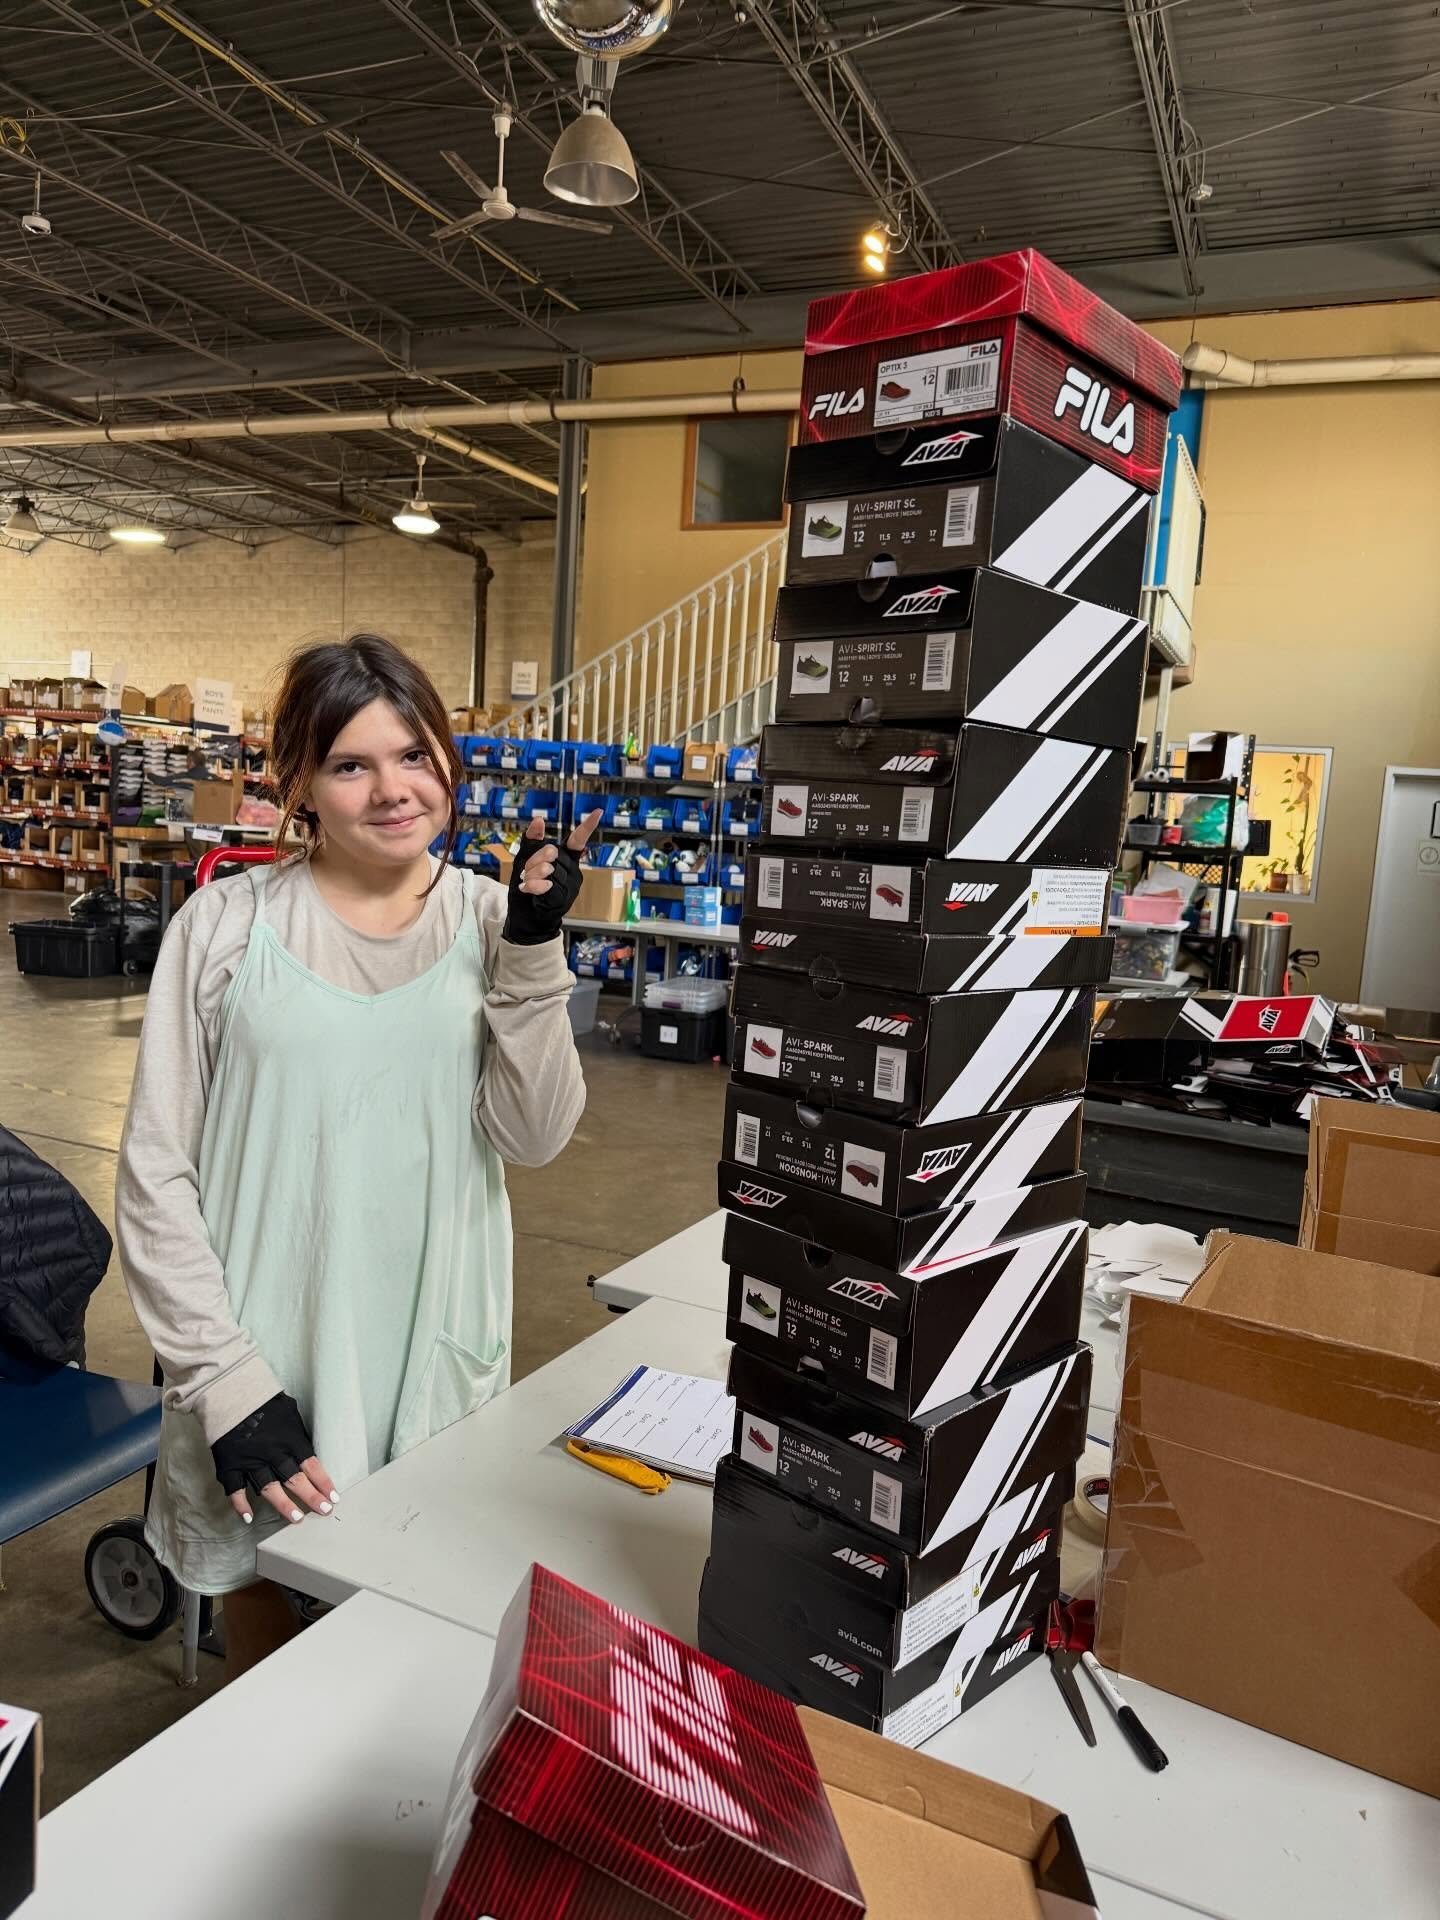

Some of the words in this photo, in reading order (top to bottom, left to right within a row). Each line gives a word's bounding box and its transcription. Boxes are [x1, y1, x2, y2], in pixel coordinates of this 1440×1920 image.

[970, 342, 998, 358] FILA
[880, 361, 901, 374] OPTIX
[922, 374, 935, 386] 12
[808, 387, 865, 421] FILA
[1053, 366, 1137, 456] FILA
[901, 437, 970, 466] AVIA
[853, 499, 902, 514] AVI-SPIRIT
[904, 498, 917, 509] SC
[853, 530, 865, 543] 12
[879, 533, 891, 541] 11.5
[929, 529, 937, 537] 17
[882, 592, 948, 617] AVIA
[838, 642, 884, 655] AVI-SPIRIT
[885, 641, 897, 652] SC
[839, 670, 850, 683] 12
[862, 674, 874, 682] 11.5
[882, 673, 897, 681] 29.5
[909, 673, 917, 681] 17
[879, 755, 936, 773] AVIA
[811, 792, 859, 803] AVI-SPARK
[807, 818, 819, 830] 12
[836, 823, 847, 831] 11.5
[882, 825, 890, 833] 18
[809, 868, 822, 876] 29.5
[831, 870, 841, 878] 11.5
[858, 872, 871, 884] 12
[946, 881, 999, 903] AVIA
[820, 897, 867, 910] AVI-SPARK
[753, 930, 798, 948] AVIA
[855, 1015, 912, 1037] AVIA
[785, 1036, 833, 1054] AVI-SPARK
[781, 1061, 793, 1074] 12
[810, 1071, 821, 1079] 11.5
[830, 1074, 844, 1084] 29.5
[857, 1080, 865, 1088] 18
[765, 1130, 771, 1138] 17
[801, 1140, 812, 1149] 11.5
[824, 1147, 836, 1161] 12
[779, 1161, 837, 1187] AVI-MONSOON
[827, 1277, 887, 1311] AVIA
[785, 1296, 829, 1322] AVI-SPIRIT
[830, 1315, 841, 1327] SC
[786, 1321, 797, 1336] 12
[809, 1336, 820, 1347] 11.5
[829, 1345, 842, 1357] 29.5
[854, 1356, 862, 1365] 17
[782, 1435, 830, 1464] AVI-SPARK
[848, 1431, 903, 1463] AVIA
[778, 1458, 790, 1473] 12
[807, 1476, 818, 1487] 11.5
[827, 1486, 841, 1498] 29.5
[854, 1498, 862, 1508] 18
[831, 1547, 887, 1580] AVIA
[1009, 1535, 1049, 1576] AVIA
[837, 1627, 884, 1658] avia.com
[990, 1633, 1031, 1677] AVIA
[808, 1653, 863, 1688] AVIA
